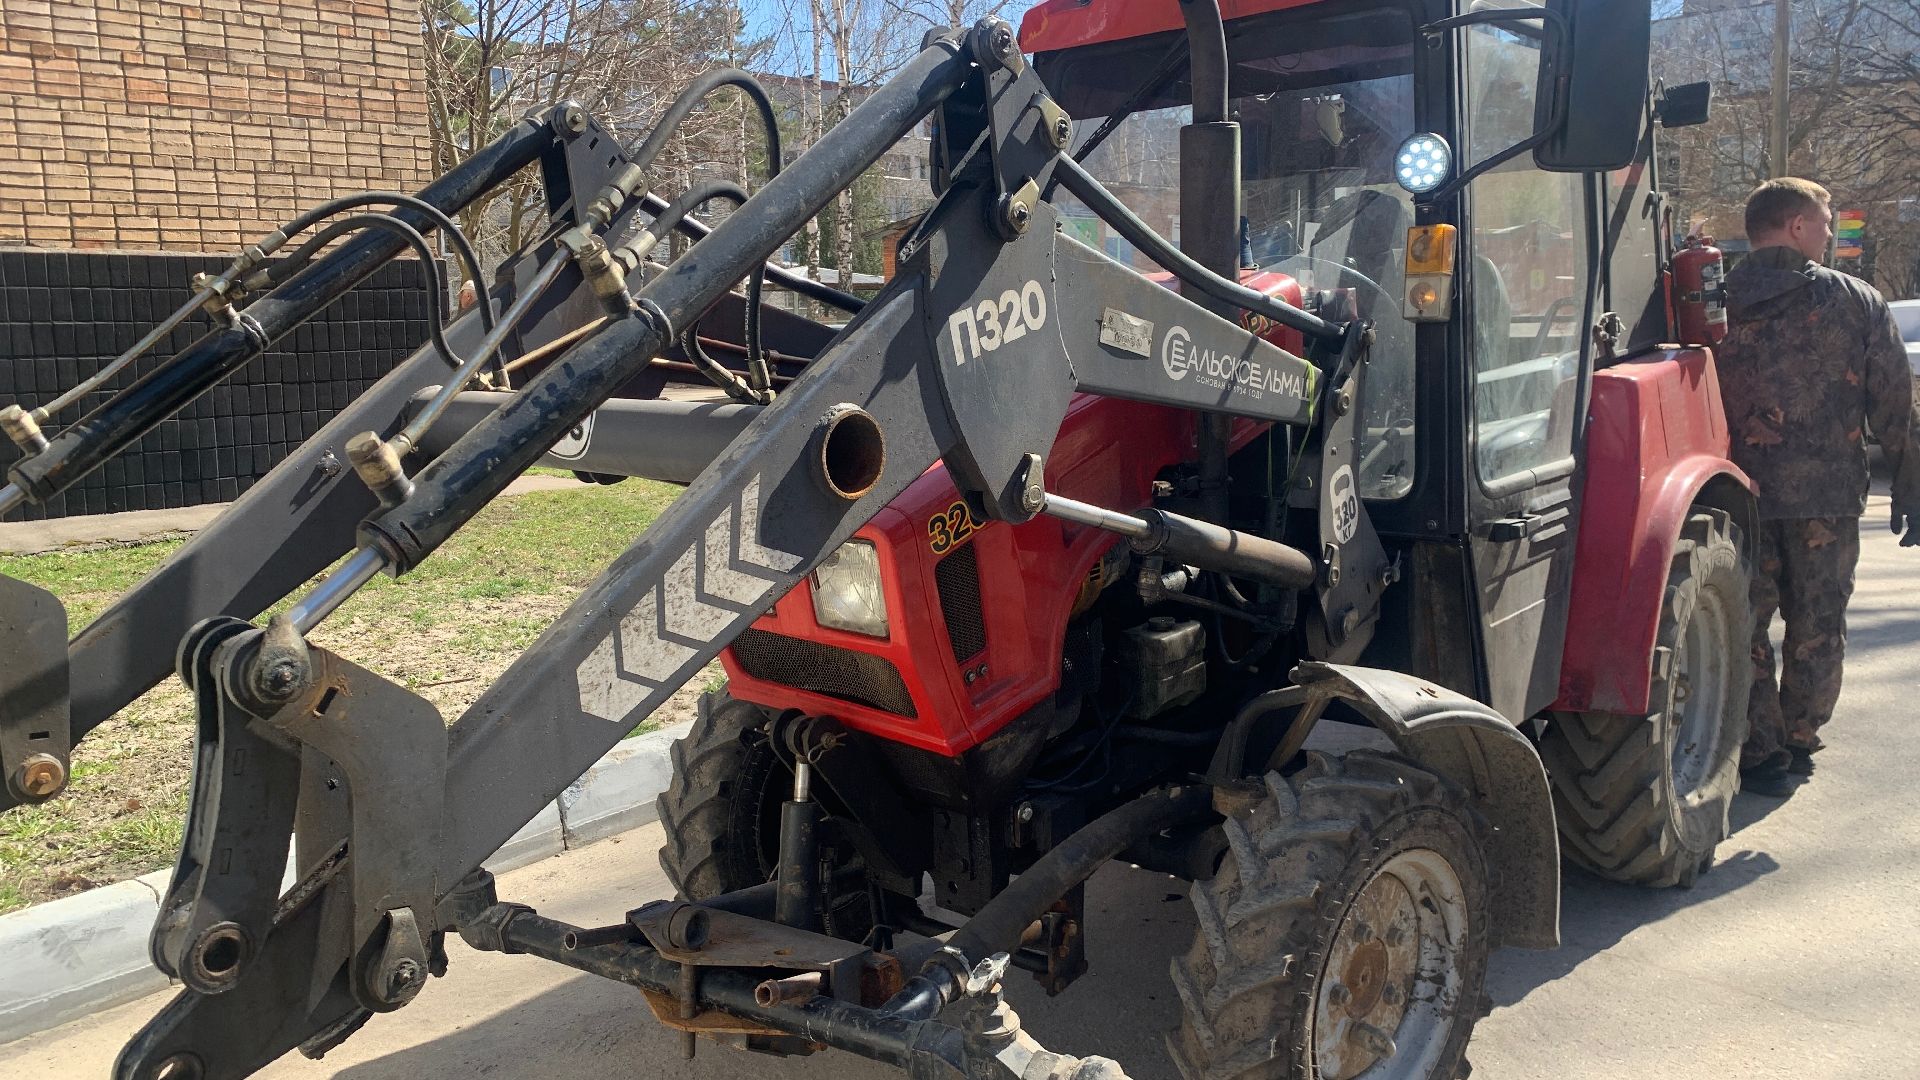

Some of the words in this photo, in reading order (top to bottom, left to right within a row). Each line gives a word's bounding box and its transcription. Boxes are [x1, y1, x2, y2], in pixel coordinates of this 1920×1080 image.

[949, 279, 1046, 366] П320
[927, 500, 987, 555] 32
[1334, 495, 1357, 531] 320
